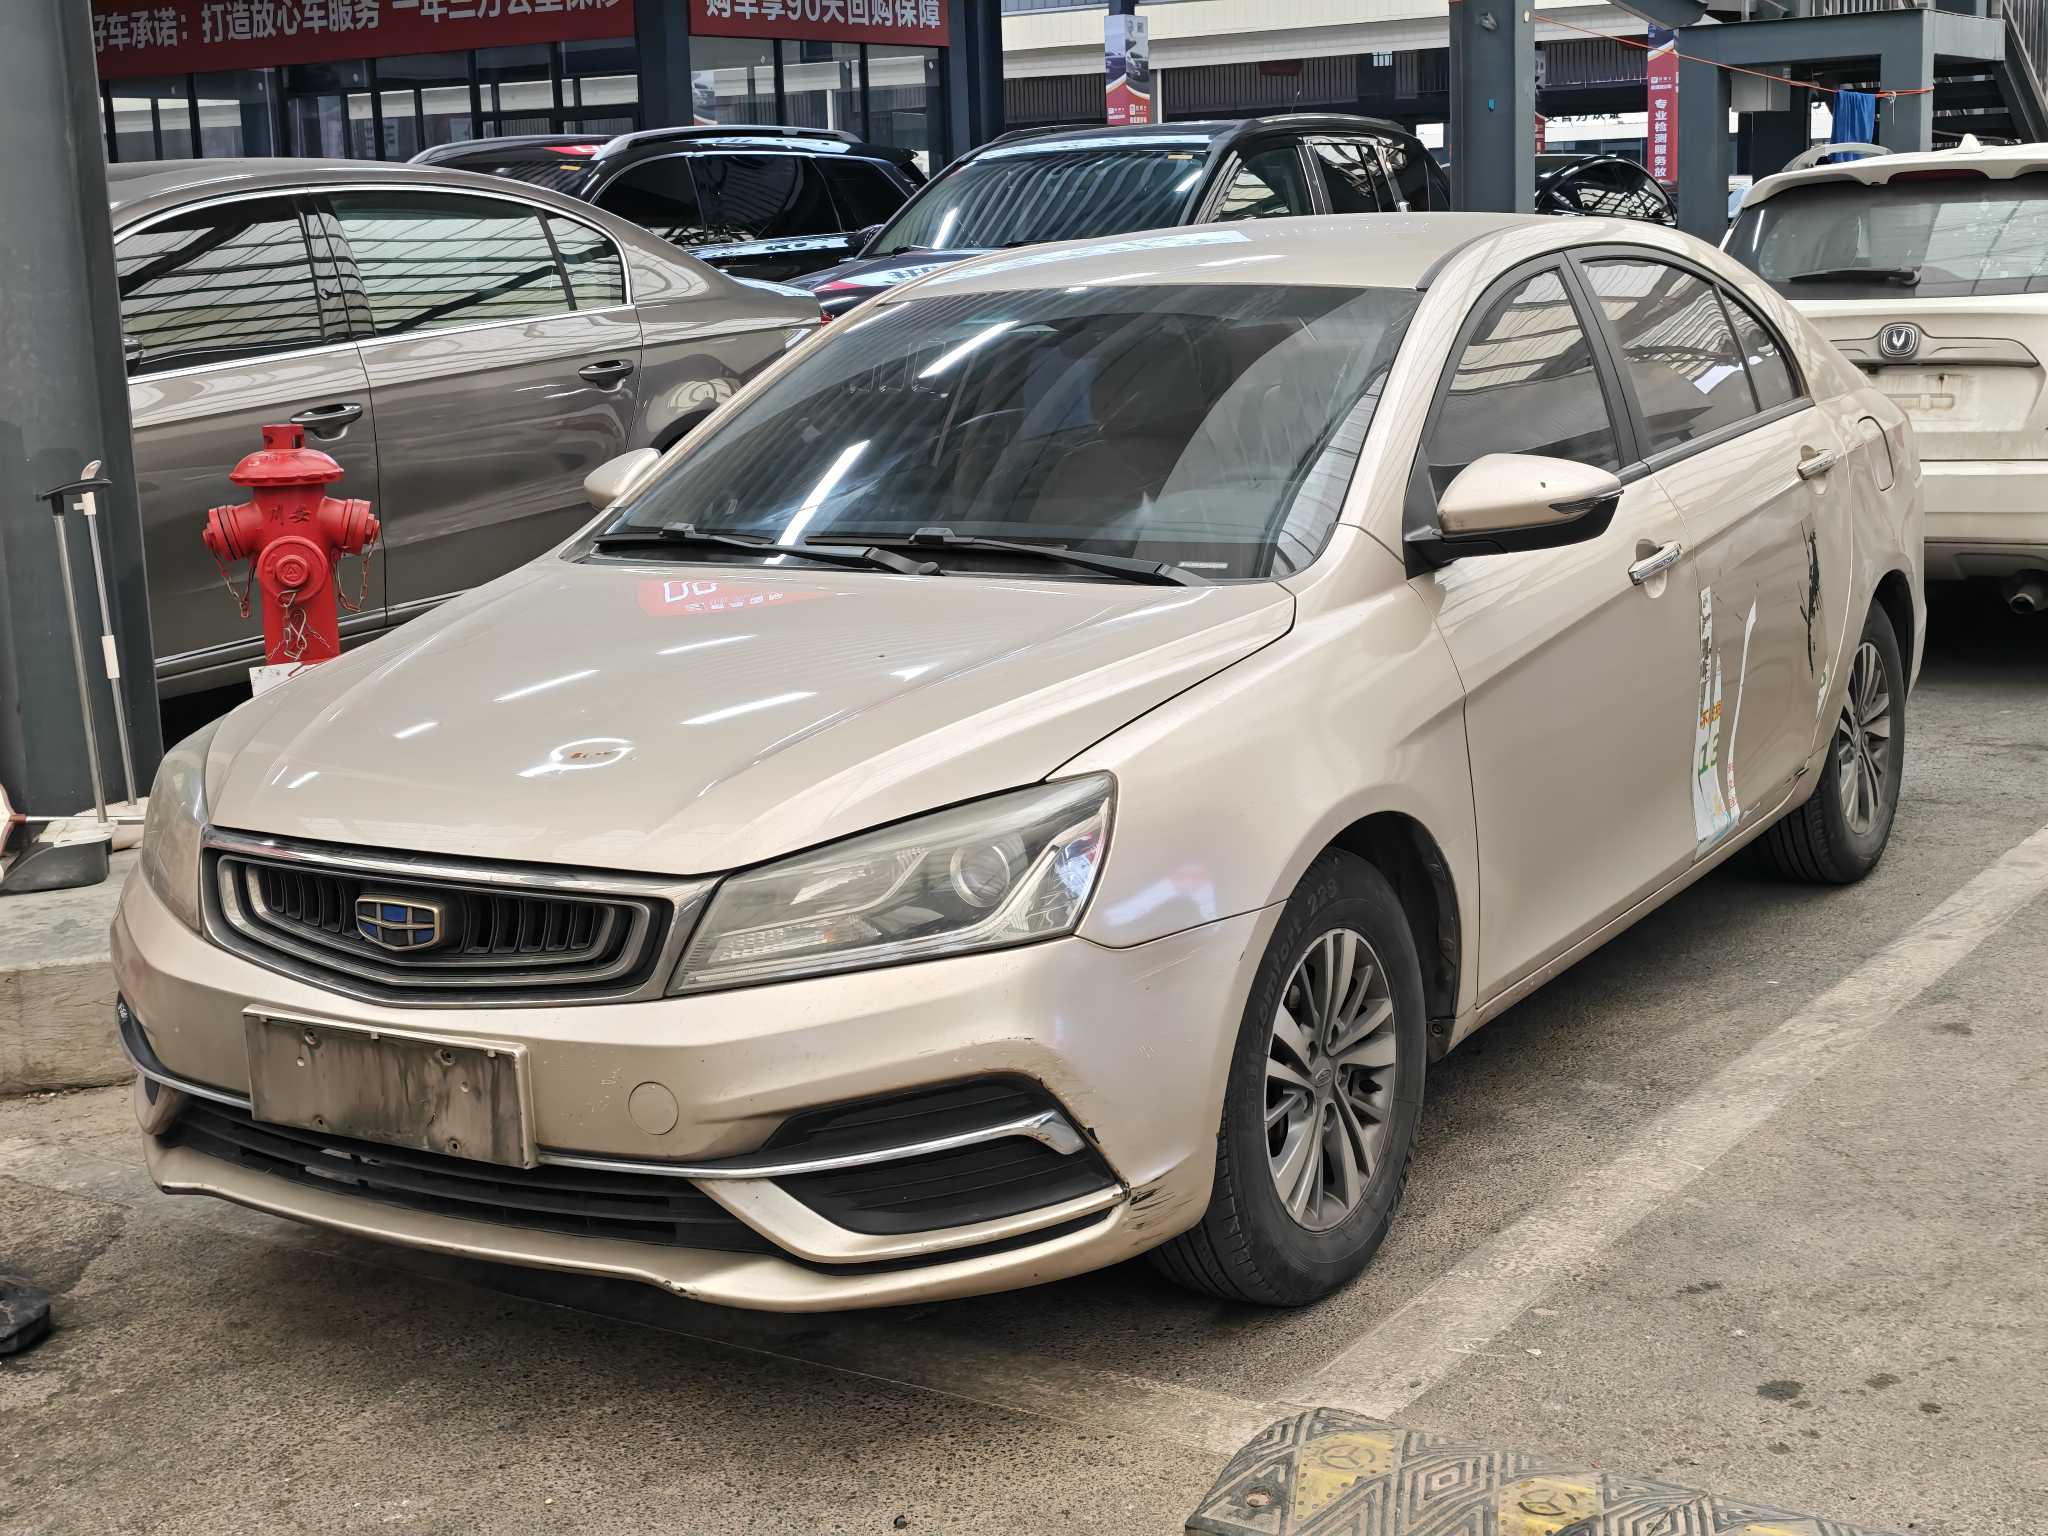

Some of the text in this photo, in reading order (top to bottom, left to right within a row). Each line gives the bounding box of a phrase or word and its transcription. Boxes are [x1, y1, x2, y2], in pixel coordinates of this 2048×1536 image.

[201, 0, 380, 43] 打造放心车服务
